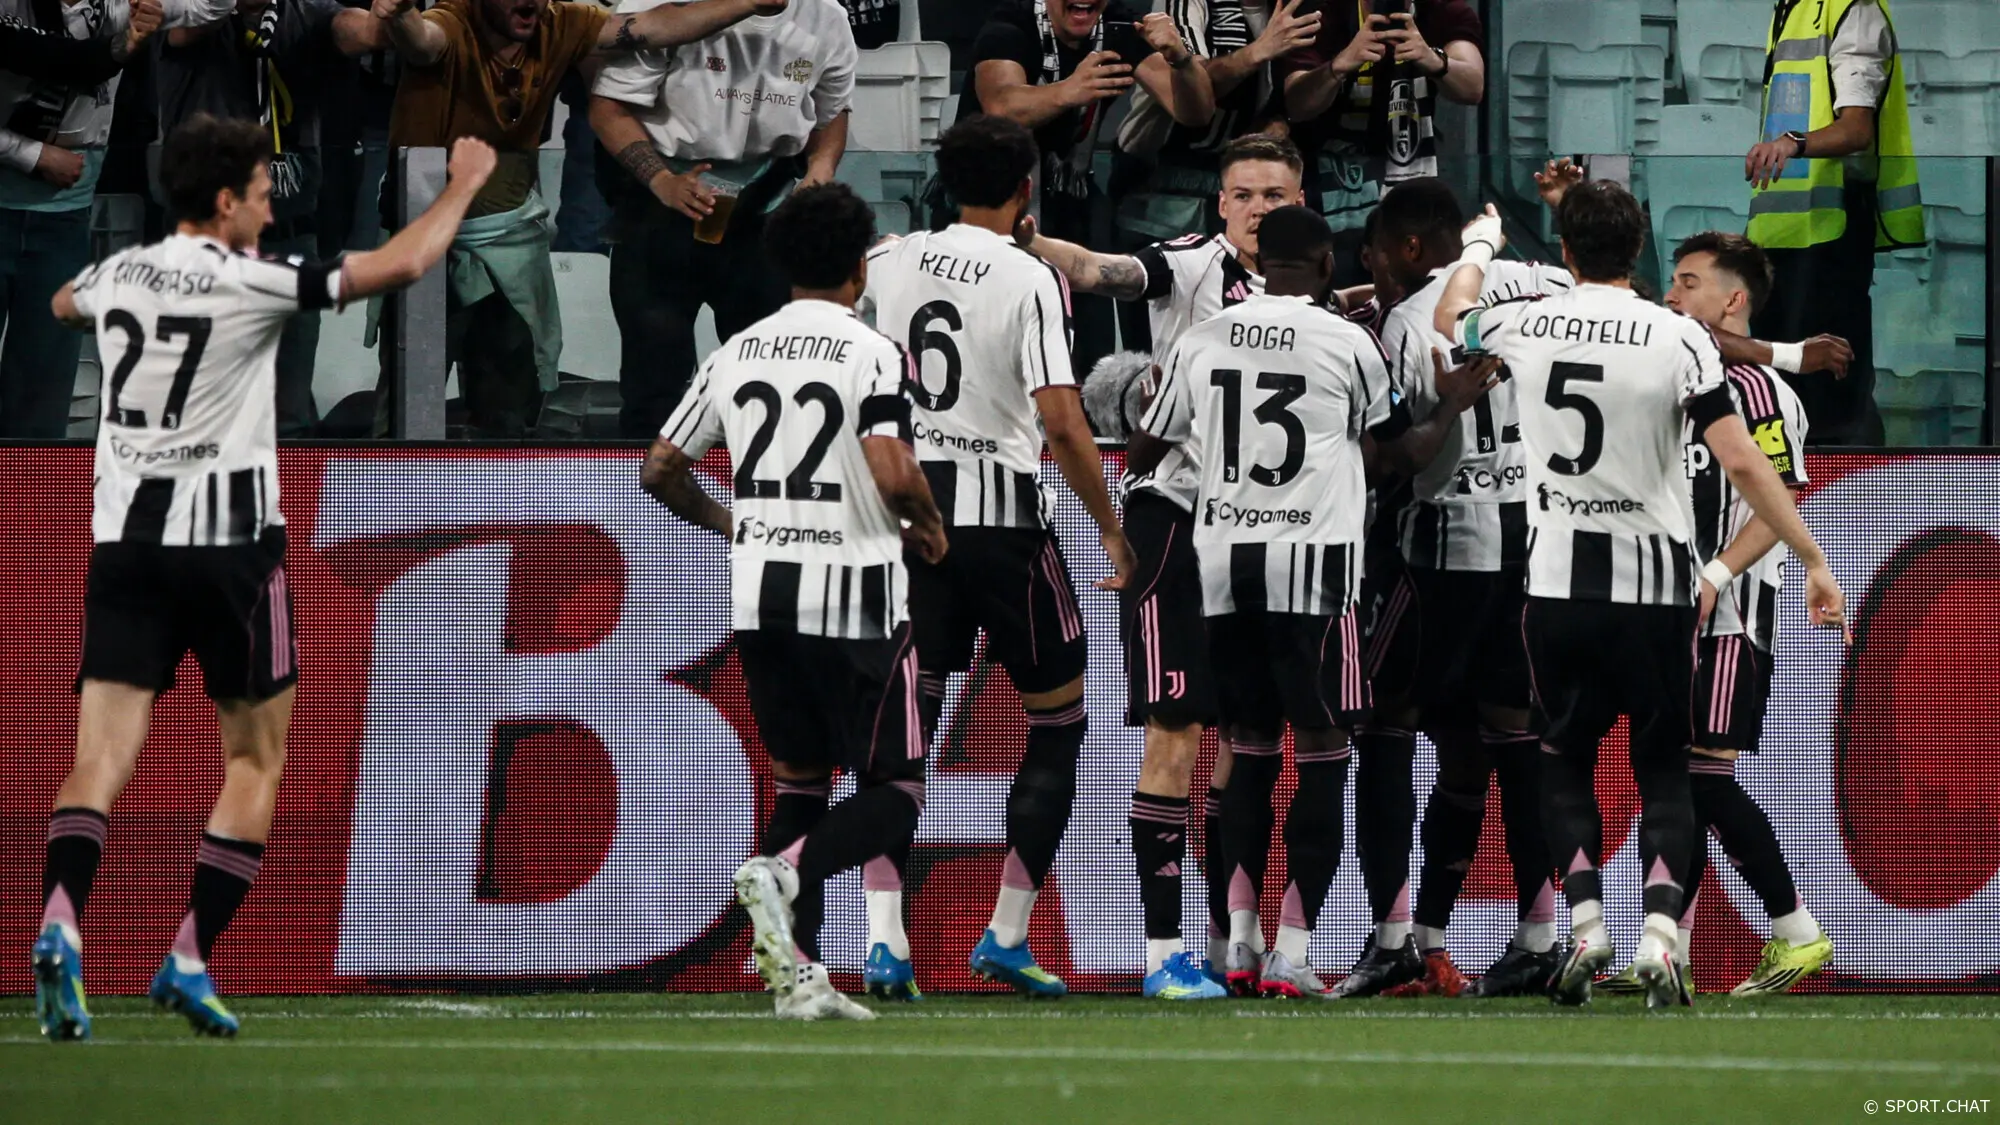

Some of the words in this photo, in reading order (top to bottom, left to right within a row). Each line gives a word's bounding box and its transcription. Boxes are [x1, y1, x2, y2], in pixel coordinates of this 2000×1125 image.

[919, 252, 991, 285] KELLY
[1230, 322, 1296, 351] BOGA
[1520, 315, 1652, 347] LOCATELLI
[739, 336, 853, 363] McKENNIE
[909, 300, 962, 412] 6
[104, 309, 212, 430] 27
[1210, 369, 1307, 487] 13
[1545, 361, 1604, 476] 5
[733, 381, 844, 502] 22
[1475, 465, 1526, 490] Cyga
[1219, 502, 1312, 527] Cygames
[752, 521, 843, 546] Cygames
